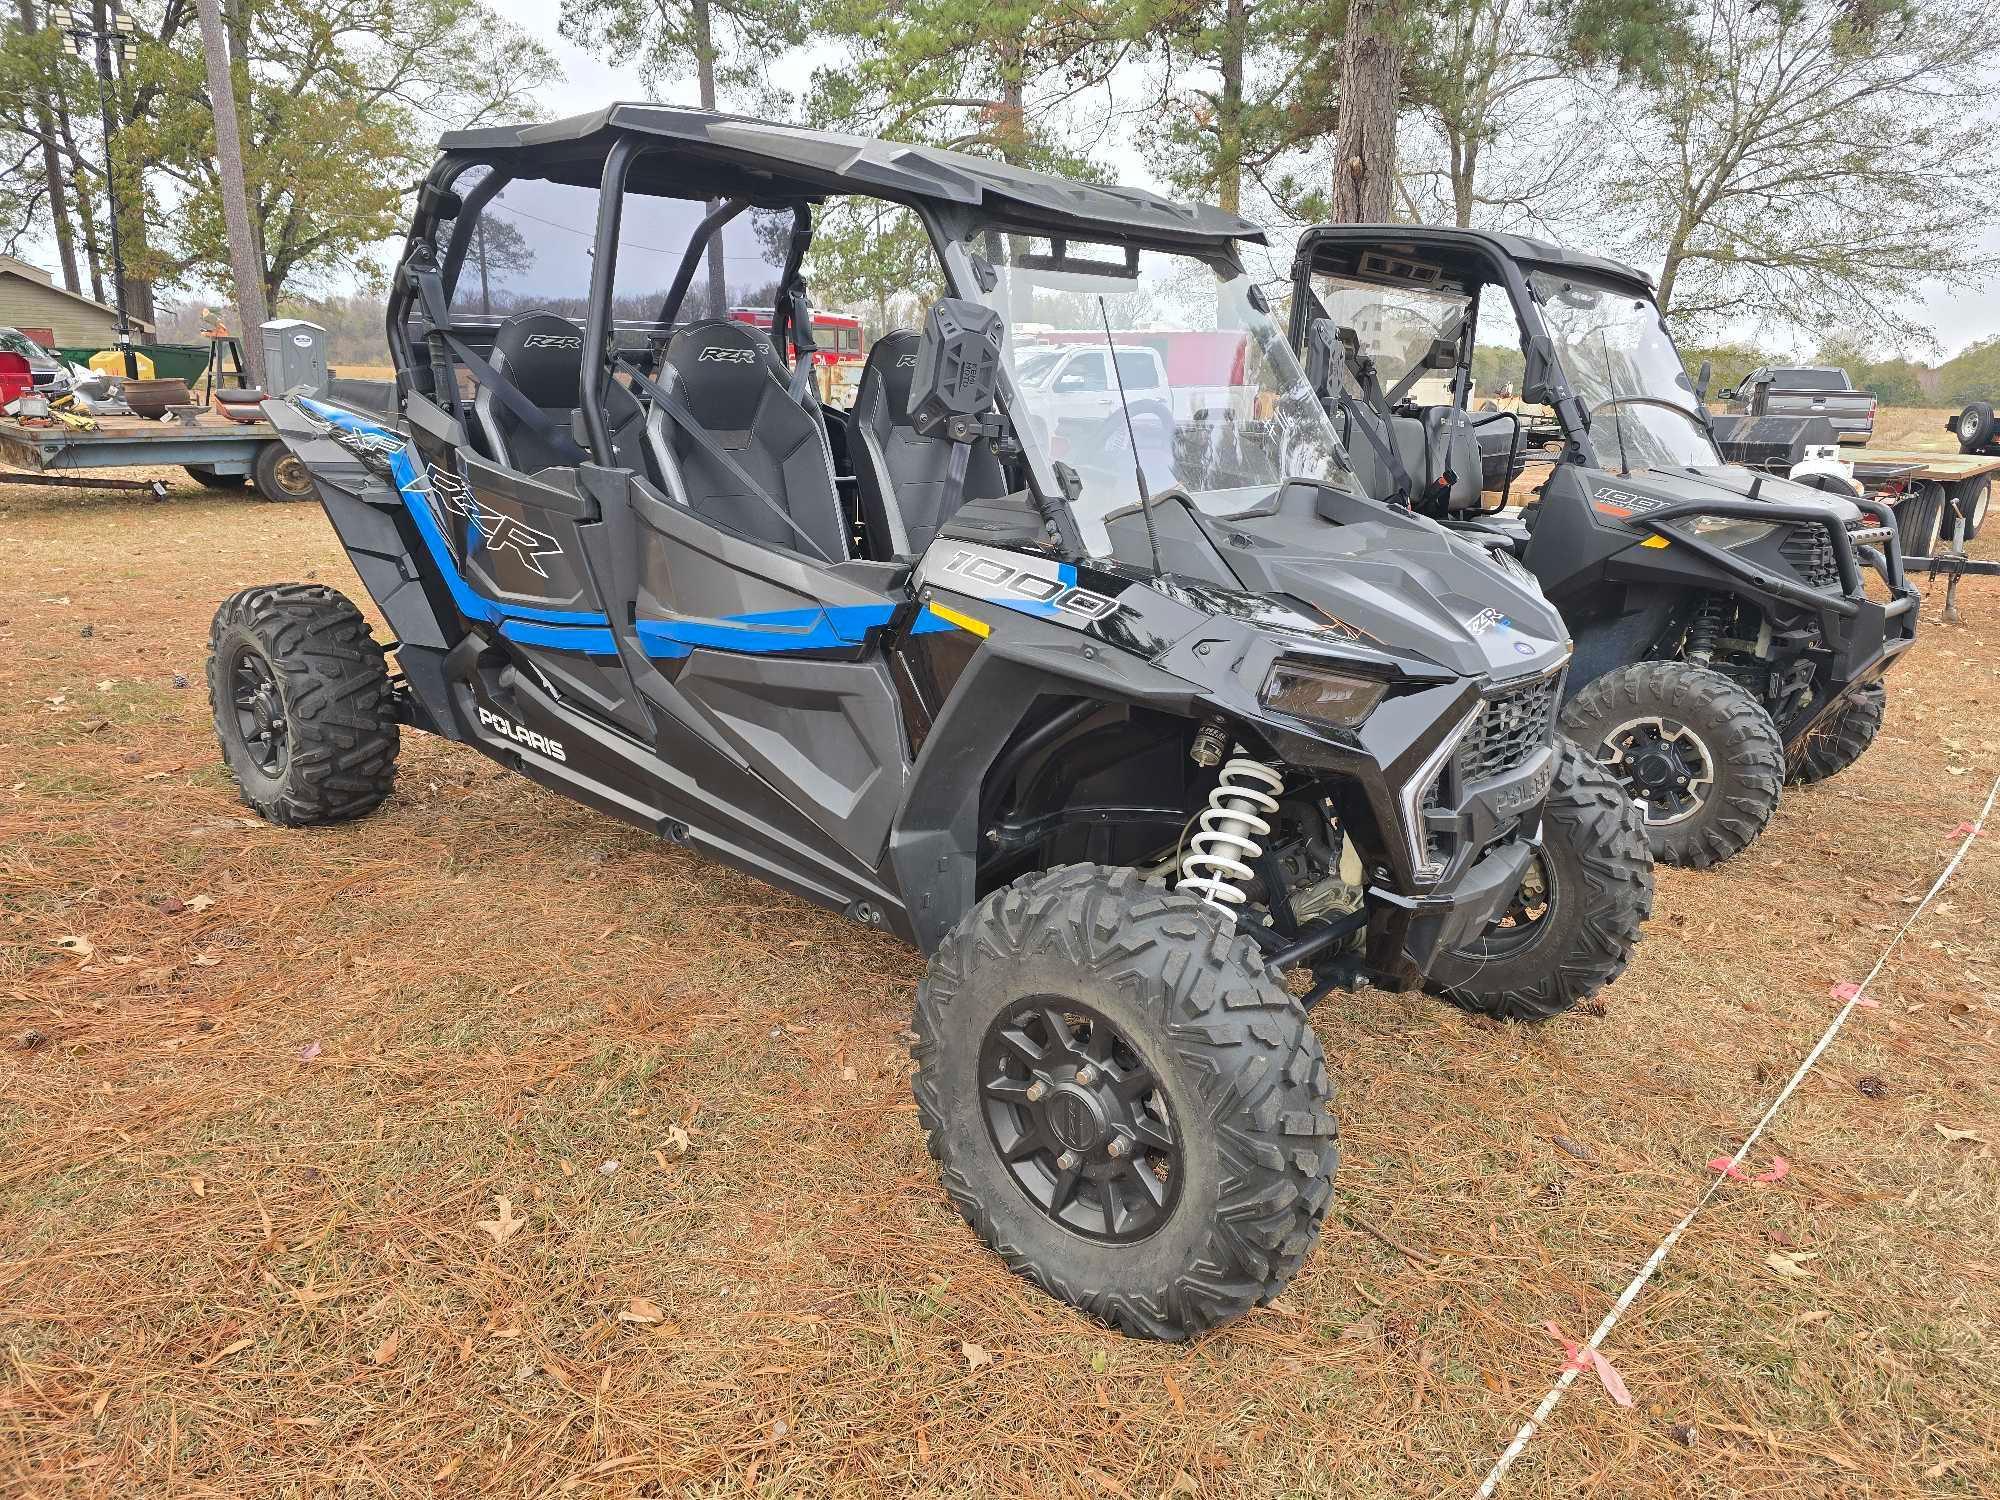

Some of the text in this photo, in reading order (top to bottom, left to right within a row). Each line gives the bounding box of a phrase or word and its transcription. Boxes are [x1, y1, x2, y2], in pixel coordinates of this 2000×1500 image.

[523, 334, 582, 349] RZR
[698, 346, 755, 364] RZR
[400, 463, 563, 578] RZR
[943, 549, 1121, 621] 1000
[479, 706, 566, 762] POLARIS
